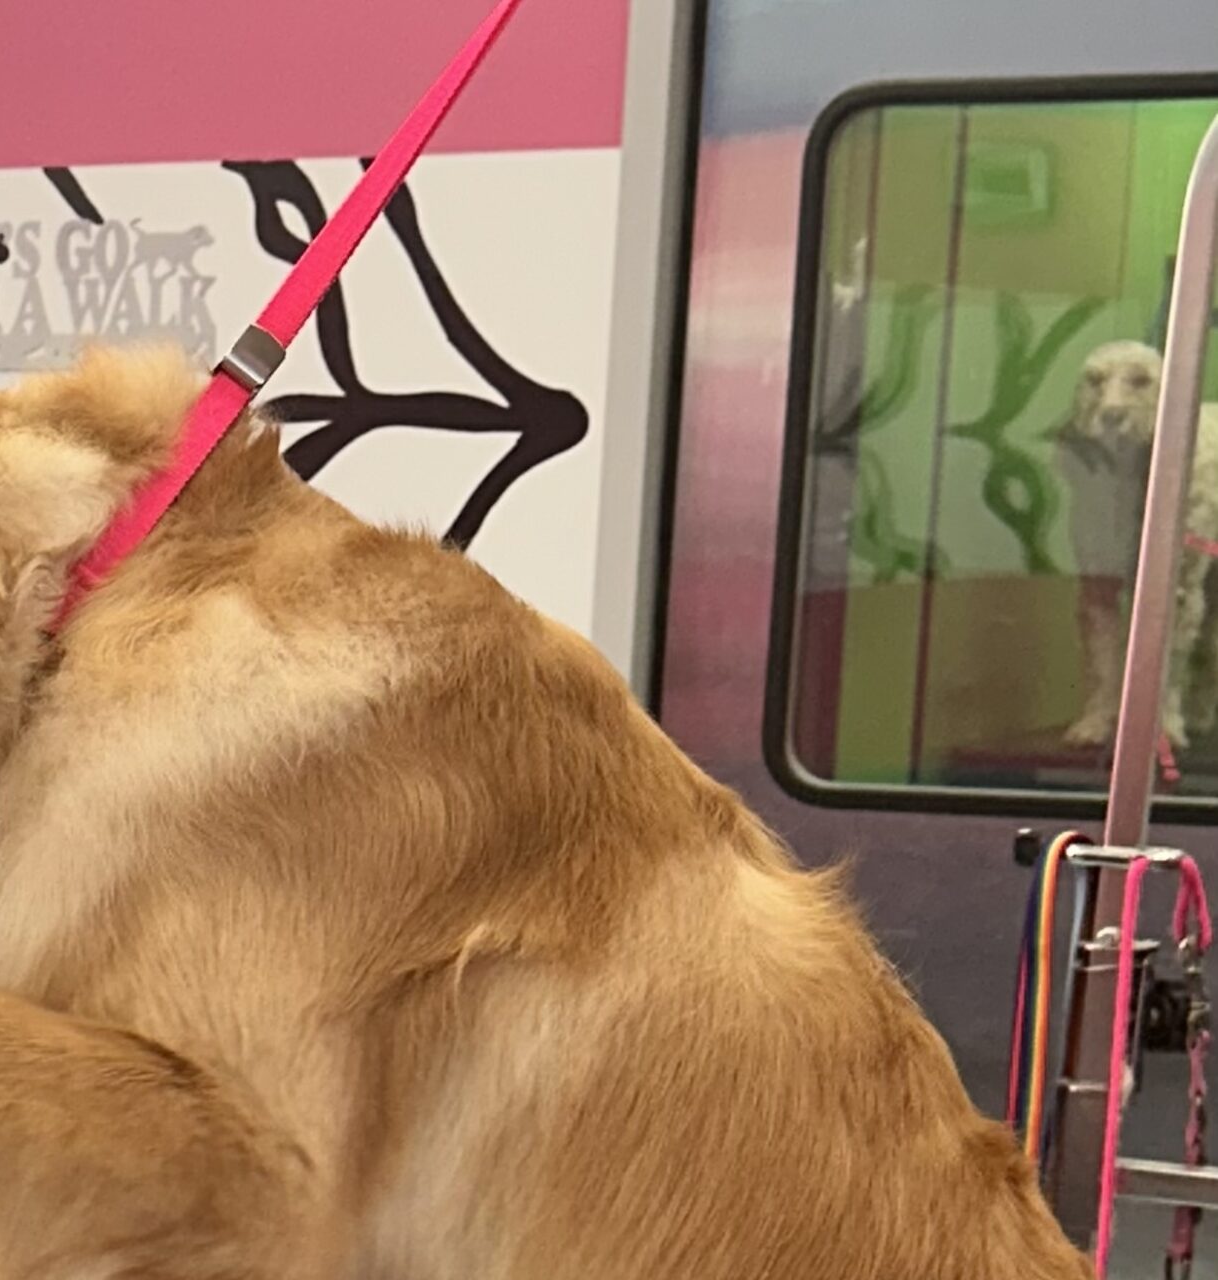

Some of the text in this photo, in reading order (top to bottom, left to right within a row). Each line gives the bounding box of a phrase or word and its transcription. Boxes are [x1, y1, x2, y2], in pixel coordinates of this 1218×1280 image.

[55, 219, 130, 279] GO
[13, 276, 52, 337] A
[62, 273, 217, 337] WALK
